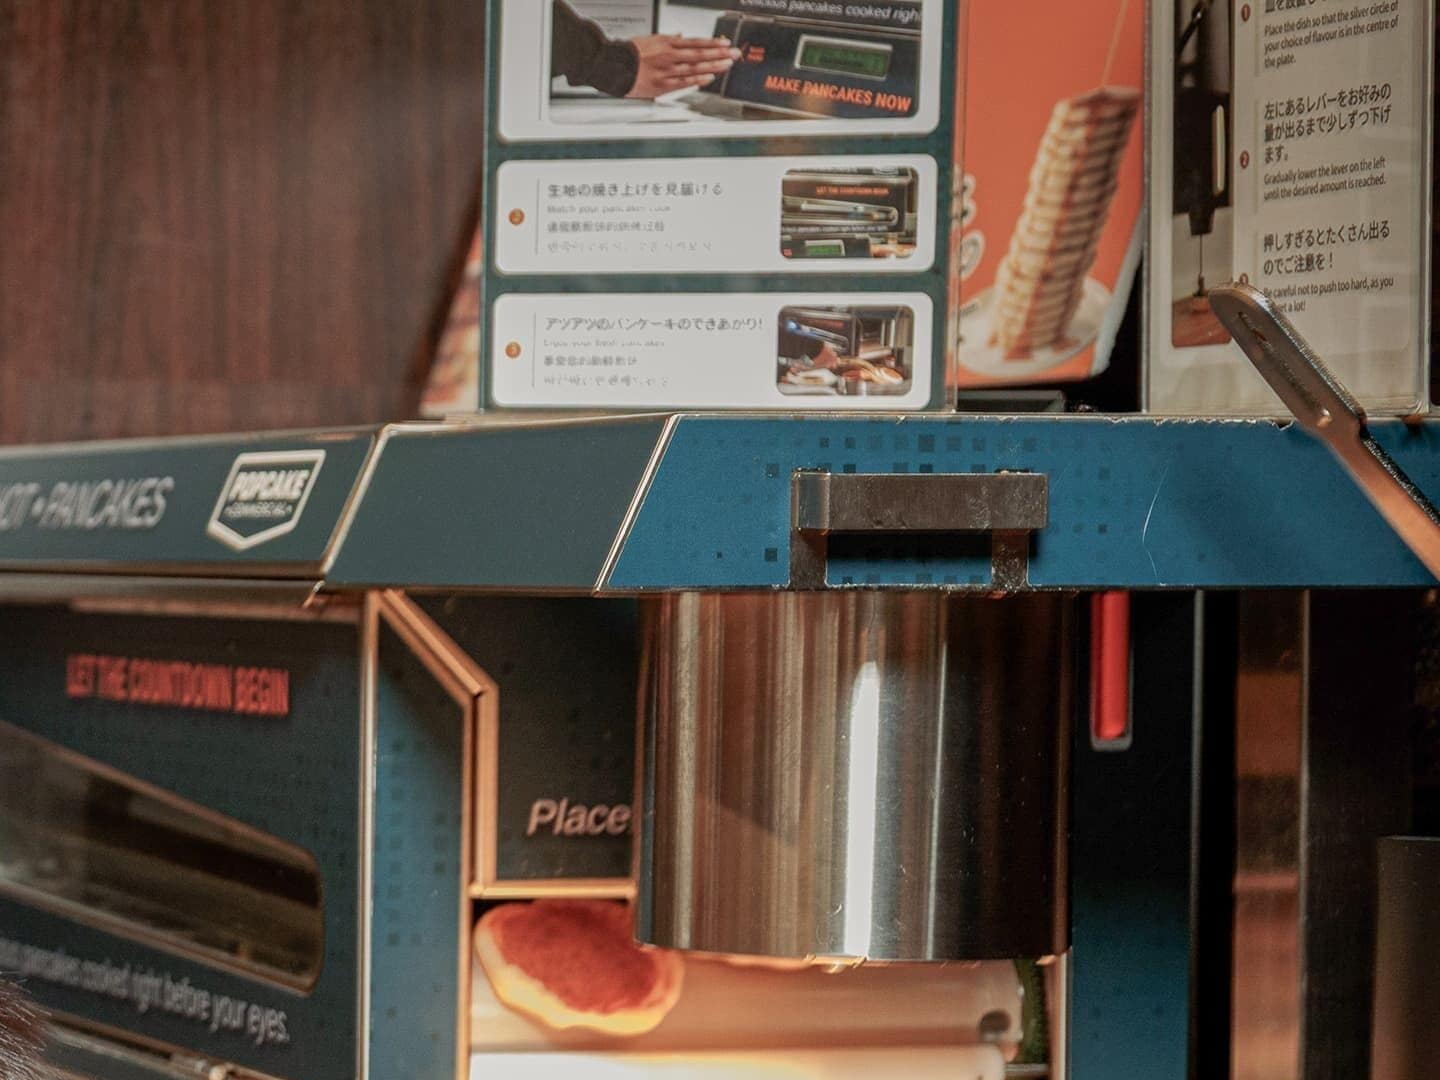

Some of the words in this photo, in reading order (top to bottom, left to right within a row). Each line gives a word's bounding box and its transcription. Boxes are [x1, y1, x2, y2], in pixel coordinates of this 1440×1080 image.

[789, 1, 842, 16] pancakes
[846, 5, 891, 20] cooked
[1264, 24, 1282, 37] Place
[1284, 20, 1295, 32] the
[1296, 16, 1311, 30] dish
[1312, 18, 1320, 28] so
[1322, 12, 1336, 24] that
[1338, 9, 1348, 21] the
[1350, 6, 1369, 20] silver
[1370, 1, 1389, 16] circle
[1390, 0, 1398, 12] of
[1264, 40, 1280, 54] your
[1280, 35, 1303, 49] choice
[1304, 31, 1312, 44] of
[1312, 30, 1338, 43] flavour
[1338, 26, 1344, 38] is
[1346, 25, 1352, 36] in
[1354, 22, 1364, 35] the
[1366, 19, 1390, 32] centre
[1390, 14, 1399, 28] of
[1264, 56, 1275, 68] the
[1276, 53, 1296, 69] plate.
[764, 74, 800, 92] MAKE
[803, 81, 872, 106] PANCAKES
[875, 93, 911, 112] NOW
[1264, 82, 1392, 120] 左にあるレバーをお好みの
[1264, 104, 1392, 142] 量が出るまで少しずつ下げ
[1264, 144, 1288, 164] ます。
[1264, 166, 1296, 185] Gradually
[1298, 165, 1316, 181] lower
[1318, 163, 1330, 176] the
[1331, 160, 1348, 174] lever
[1349, 162, 1359, 173] on
[1360, 158, 1372, 172] the
[1372, 155, 1386, 170] left
[1264, 186, 1280, 200] until
[1280, 184, 1292, 198] the
[1292, 180, 1318, 197] desired
[1320, 178, 1348, 193] amount
[1348, 177, 1354, 190] is
[1355, 172, 1386, 189] reached.
[1264, 220, 1390, 252] 押しすぎるとたくさん出る
[1273, 284, 1296, 298] careful
[1298, 284, 1310, 296] not
[1310, 282, 1318, 294] to
[1319, 280, 1337, 298] push
[1338, 280, 1350, 292] too
[1350, 277, 1370, 291] hard,
[1370, 279, 1378, 288] as
[1380, 276, 1394, 292] you
[1294, 299, 1306, 312] lot!
[39, 476, 174, 530] PANCAKES
[228, 469, 310, 502] POPCAKE
[66, 654, 96, 698] LET
[96, 655, 128, 701] THE
[128, 657, 232, 712] COUNTDOWN
[234, 666, 290, 718] BEGIN
[527, 797, 632, 837] Place
[163, 973, 210, 1021] before
[210, 993, 248, 1032] your
[248, 1003, 291, 1046] eyes.
